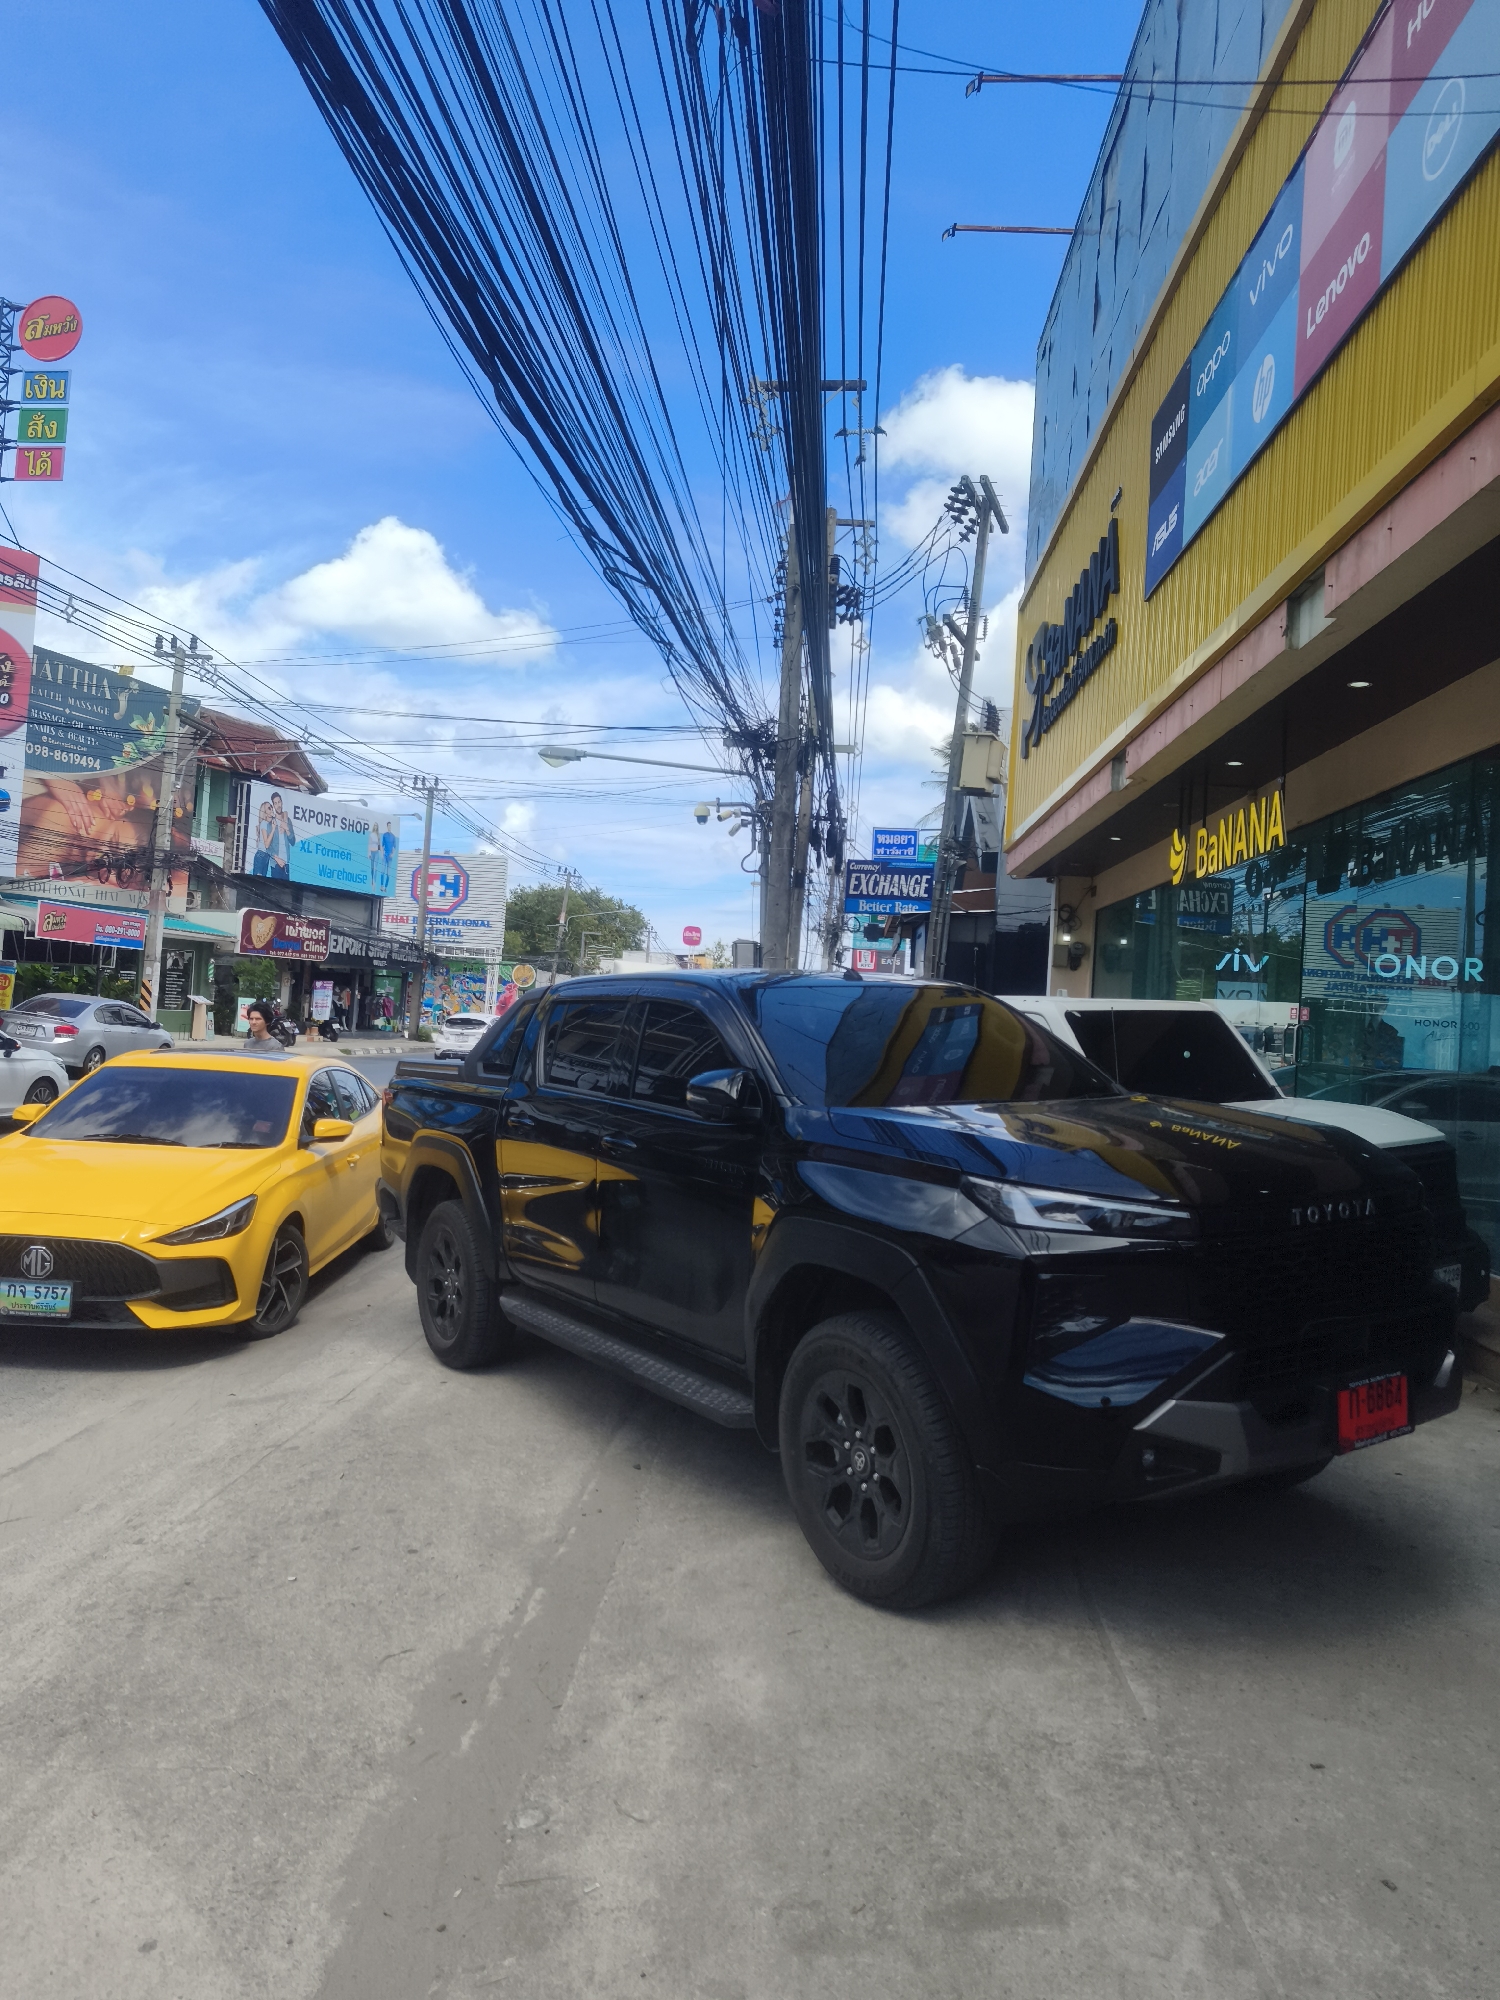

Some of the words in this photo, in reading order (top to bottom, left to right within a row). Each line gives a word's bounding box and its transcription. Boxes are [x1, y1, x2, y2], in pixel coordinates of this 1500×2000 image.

[1249, 223, 1293, 306] vivo
[1306, 232, 1371, 339] Lenovo
[24, 314, 78, 342] สมหวัง
[25, 373, 66, 400] เงิน
[27, 411, 58, 439] สั่ง
[1155, 404, 1186, 465] SAMSUNG
[24, 450, 52, 476] ได้
[1193, 438, 1224, 497] acer
[1151, 502, 1179, 558] ASUS
[1045, 517, 1120, 695] BaNANA
[67, 696, 110, 716] MASSAGE
[25, 742, 101, 771] 098-8619494
[293, 804, 338, 829] EXPORT
[340, 816, 370, 836] SHOP
[1196, 789, 1286, 879] BaNANA
[300, 839, 313, 854] XL
[876, 833, 915, 845] หมอยา
[318, 863, 368, 885] Warehouse
[849, 861, 881, 873] Currency
[848, 872, 932, 898] EXCHANGE
[384, 914, 410, 924] THAI
[858, 899, 893, 913] Better
[894, 901, 919, 913] Rate
[303, 940, 327, 954] Clinic
[1367, 953, 1485, 983] ONOR
[1414, 1018, 1458, 1029] HONOR
[1290, 1198, 1378, 1227] TOYOTA
[22, 1248, 52, 1277] MG
[34, 1285, 69, 1301] 5757
